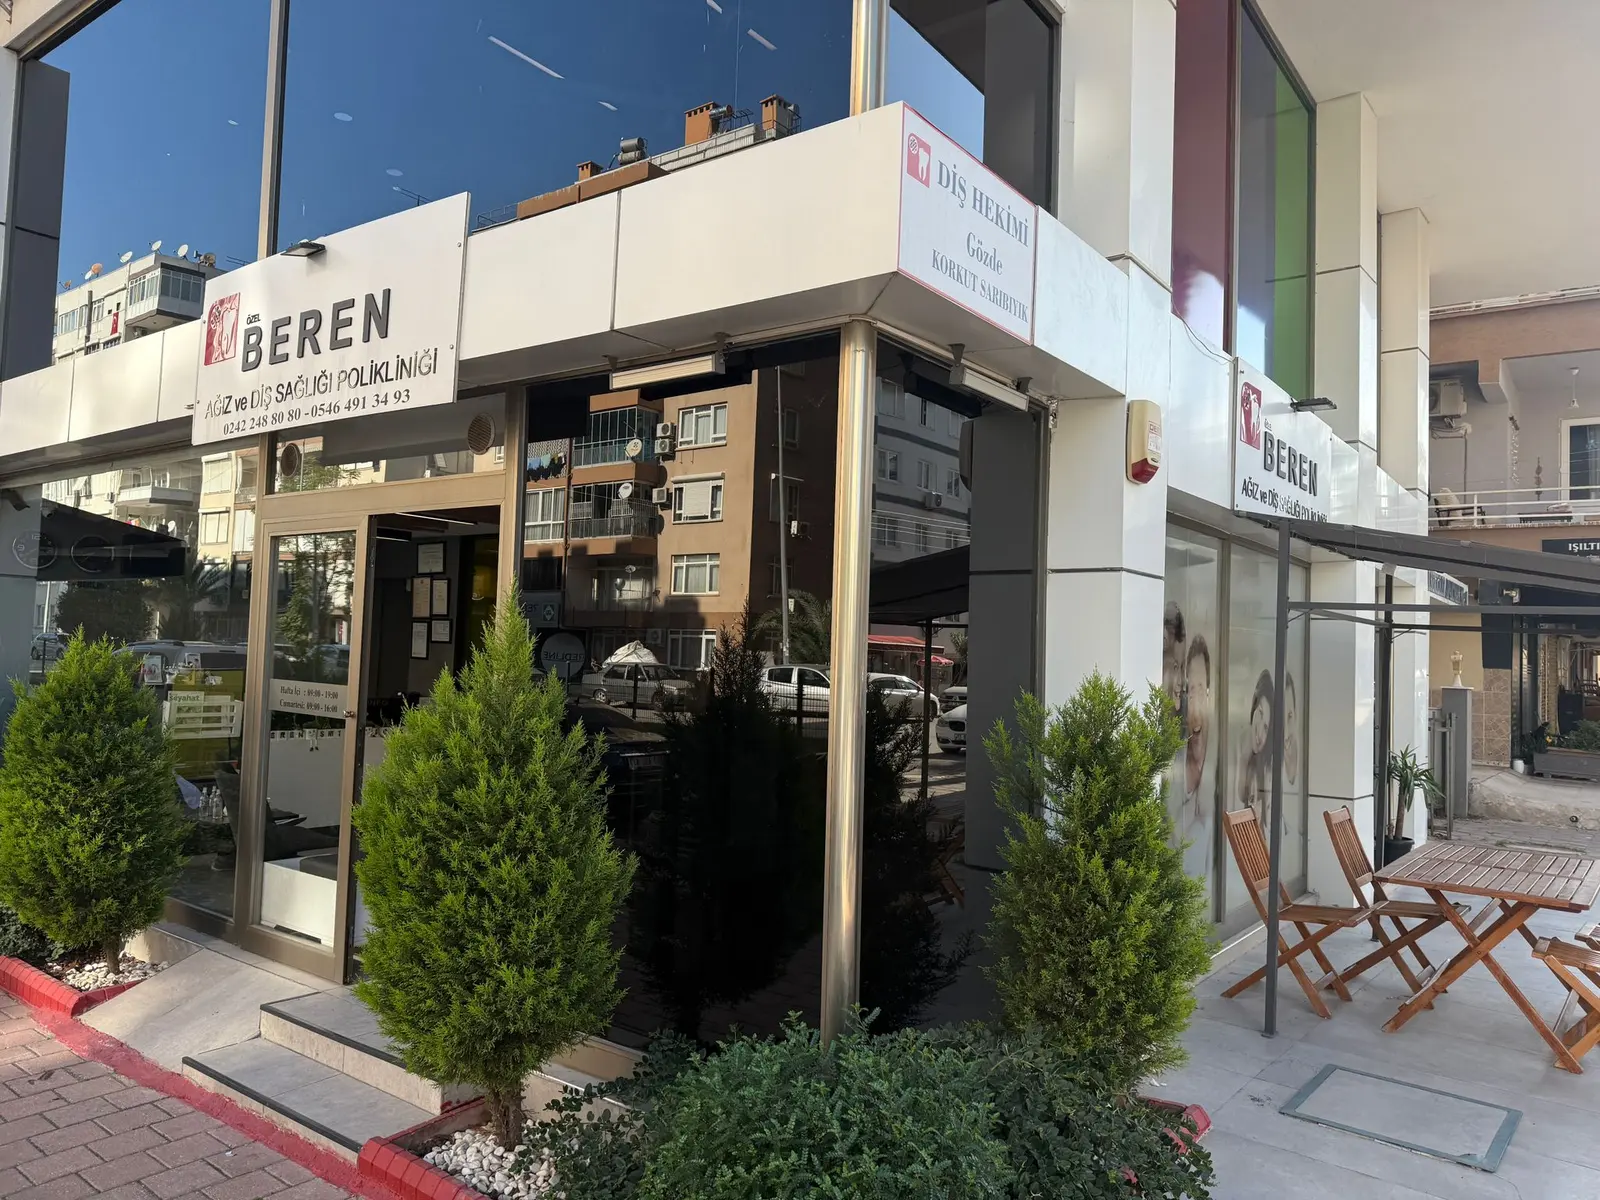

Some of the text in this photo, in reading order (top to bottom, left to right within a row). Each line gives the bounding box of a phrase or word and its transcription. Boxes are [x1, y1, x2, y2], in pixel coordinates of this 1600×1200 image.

[937, 159, 1029, 248] DİŞ HEKİMİ
[931, 248, 1029, 324] KORKUT SARIBIYIK
[966, 231, 1003, 276] Gözde
[241, 288, 391, 372] BEREN
[246, 314, 261, 325] ÖZEL
[205, 348, 438, 419] AĞIZ ve DİŞ SAĞLIĞI POLİKLİNİĞİ
[223, 420, 246, 435] 0242
[249, 415, 268, 430] 248
[271, 411, 285, 425] 80
[287, 407, 301, 421] 80
[344, 396, 367, 412] 491
[371, 392, 389, 408] 34
[393, 389, 410, 405] 93
[1241, 476, 1259, 501] AĞIZ
[1260, 489, 1267, 504] ve
[1268, 488, 1279, 513] DİŞ
[1264, 431, 1318, 497] BEREN
